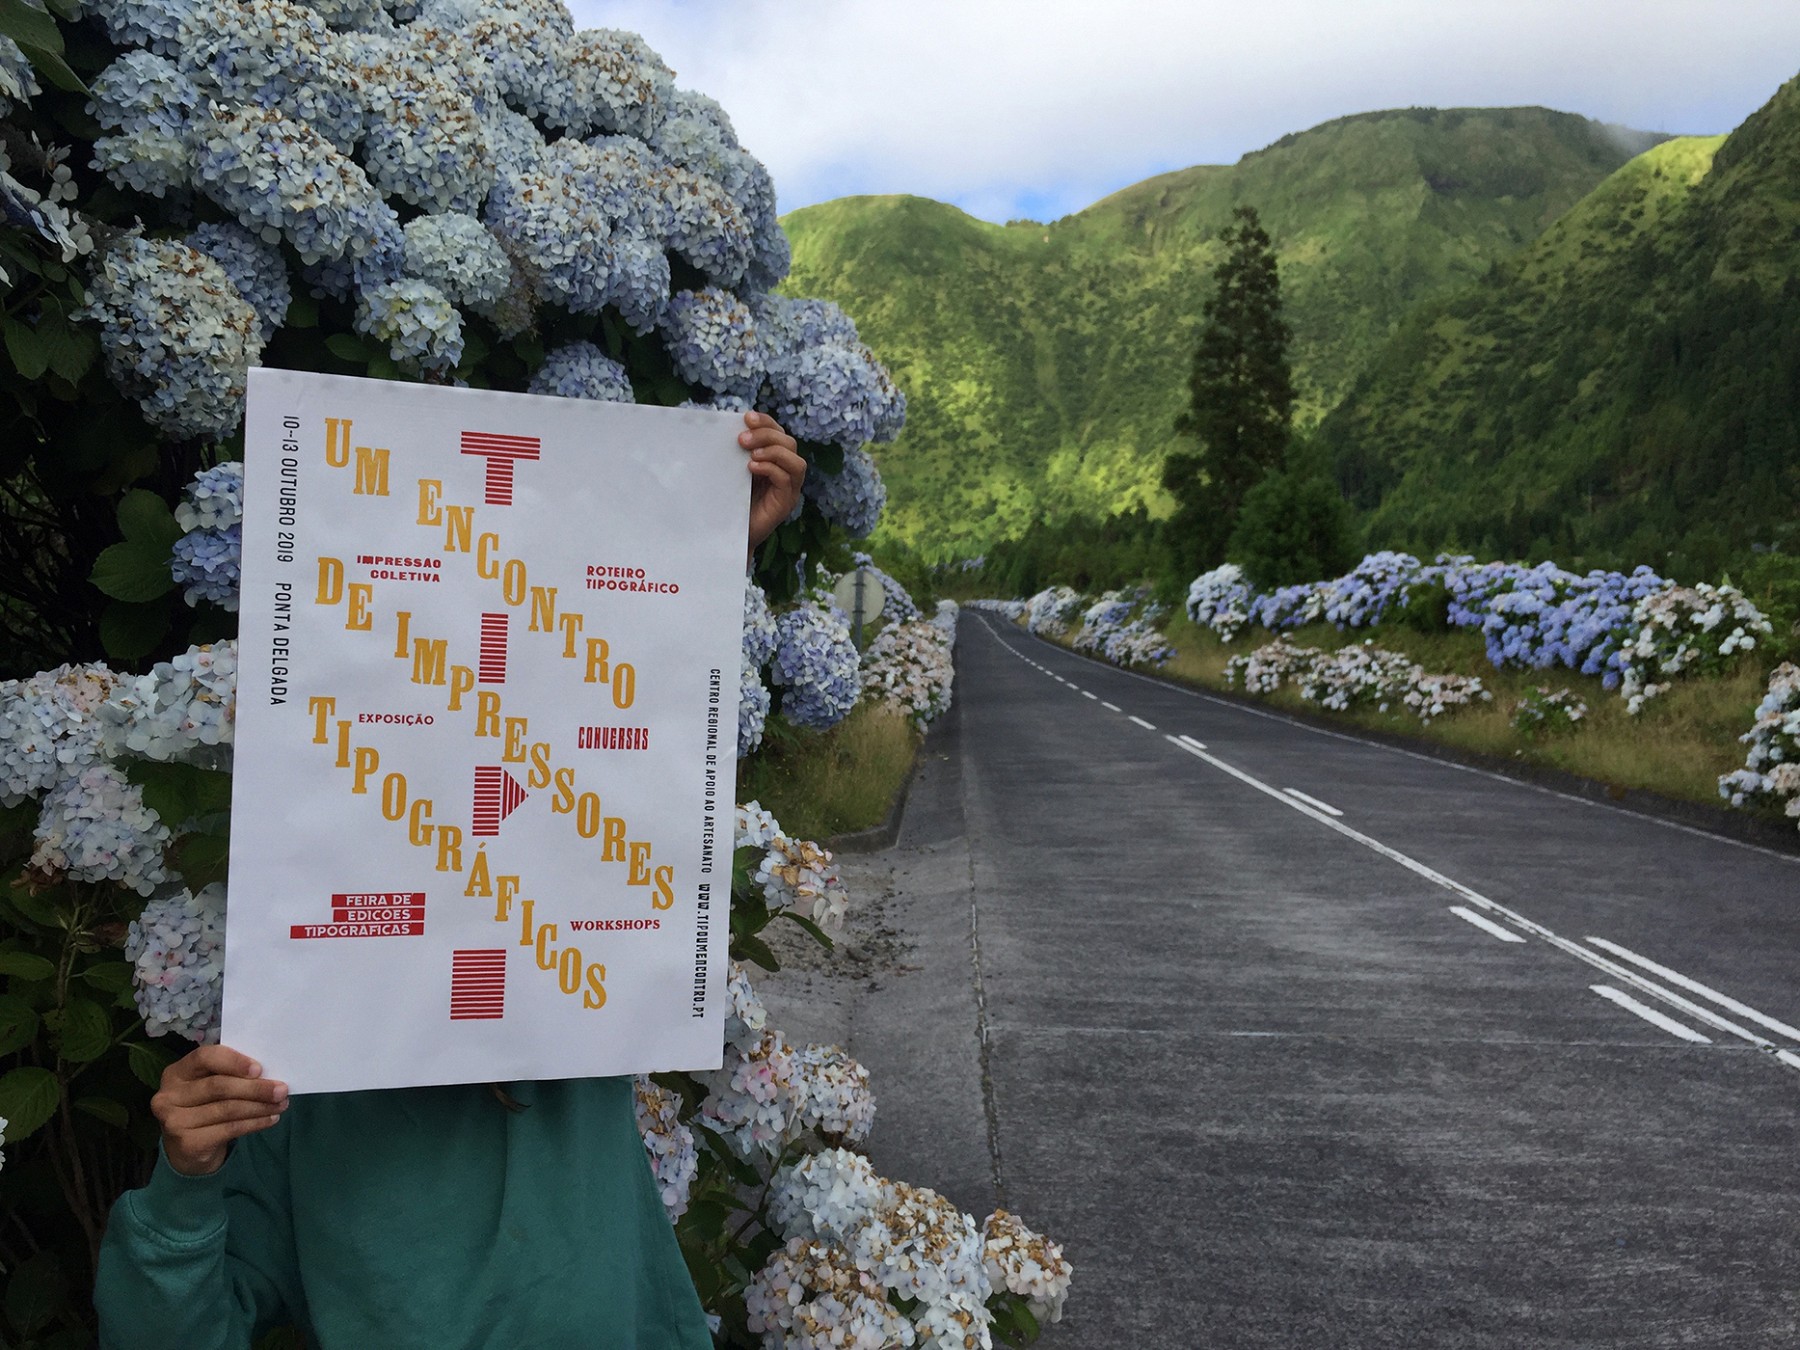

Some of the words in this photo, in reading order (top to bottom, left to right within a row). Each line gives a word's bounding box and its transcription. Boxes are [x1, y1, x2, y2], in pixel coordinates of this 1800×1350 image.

[278, 457, 299, 526] OUTUBRO
[276, 531, 295, 563] 2019
[325, 417, 390, 496] UM
[416, 479, 636, 709] ENCONTRO
[370, 569, 440, 583] COLETIVA
[586, 565, 646, 579] ROTEIRO
[585, 576, 680, 594] TIPOGRÁFICO
[273, 582, 292, 632] PONTA
[270, 637, 290, 706] DELGADA
[708, 668, 721, 704] CENTRO
[315, 557, 373, 631] DE
[394, 612, 674, 910] IMPRESSORES
[358, 713, 435, 727] EXPOSIÇÃO
[706, 706, 719, 751] REGIONAL
[578, 726, 649, 751] CONVERSAS
[705, 754, 717, 766] DE
[704, 768, 716, 797] APOIO
[704, 799, 715, 812] AO
[309, 697, 607, 1009] TIPOGRÁFICOS
[700, 815, 715, 874] ARTESANATO
[345, 896, 388, 906] FEIRA
[392, 894, 412, 905] DE
[569, 919, 661, 932] WORKSHOPS
